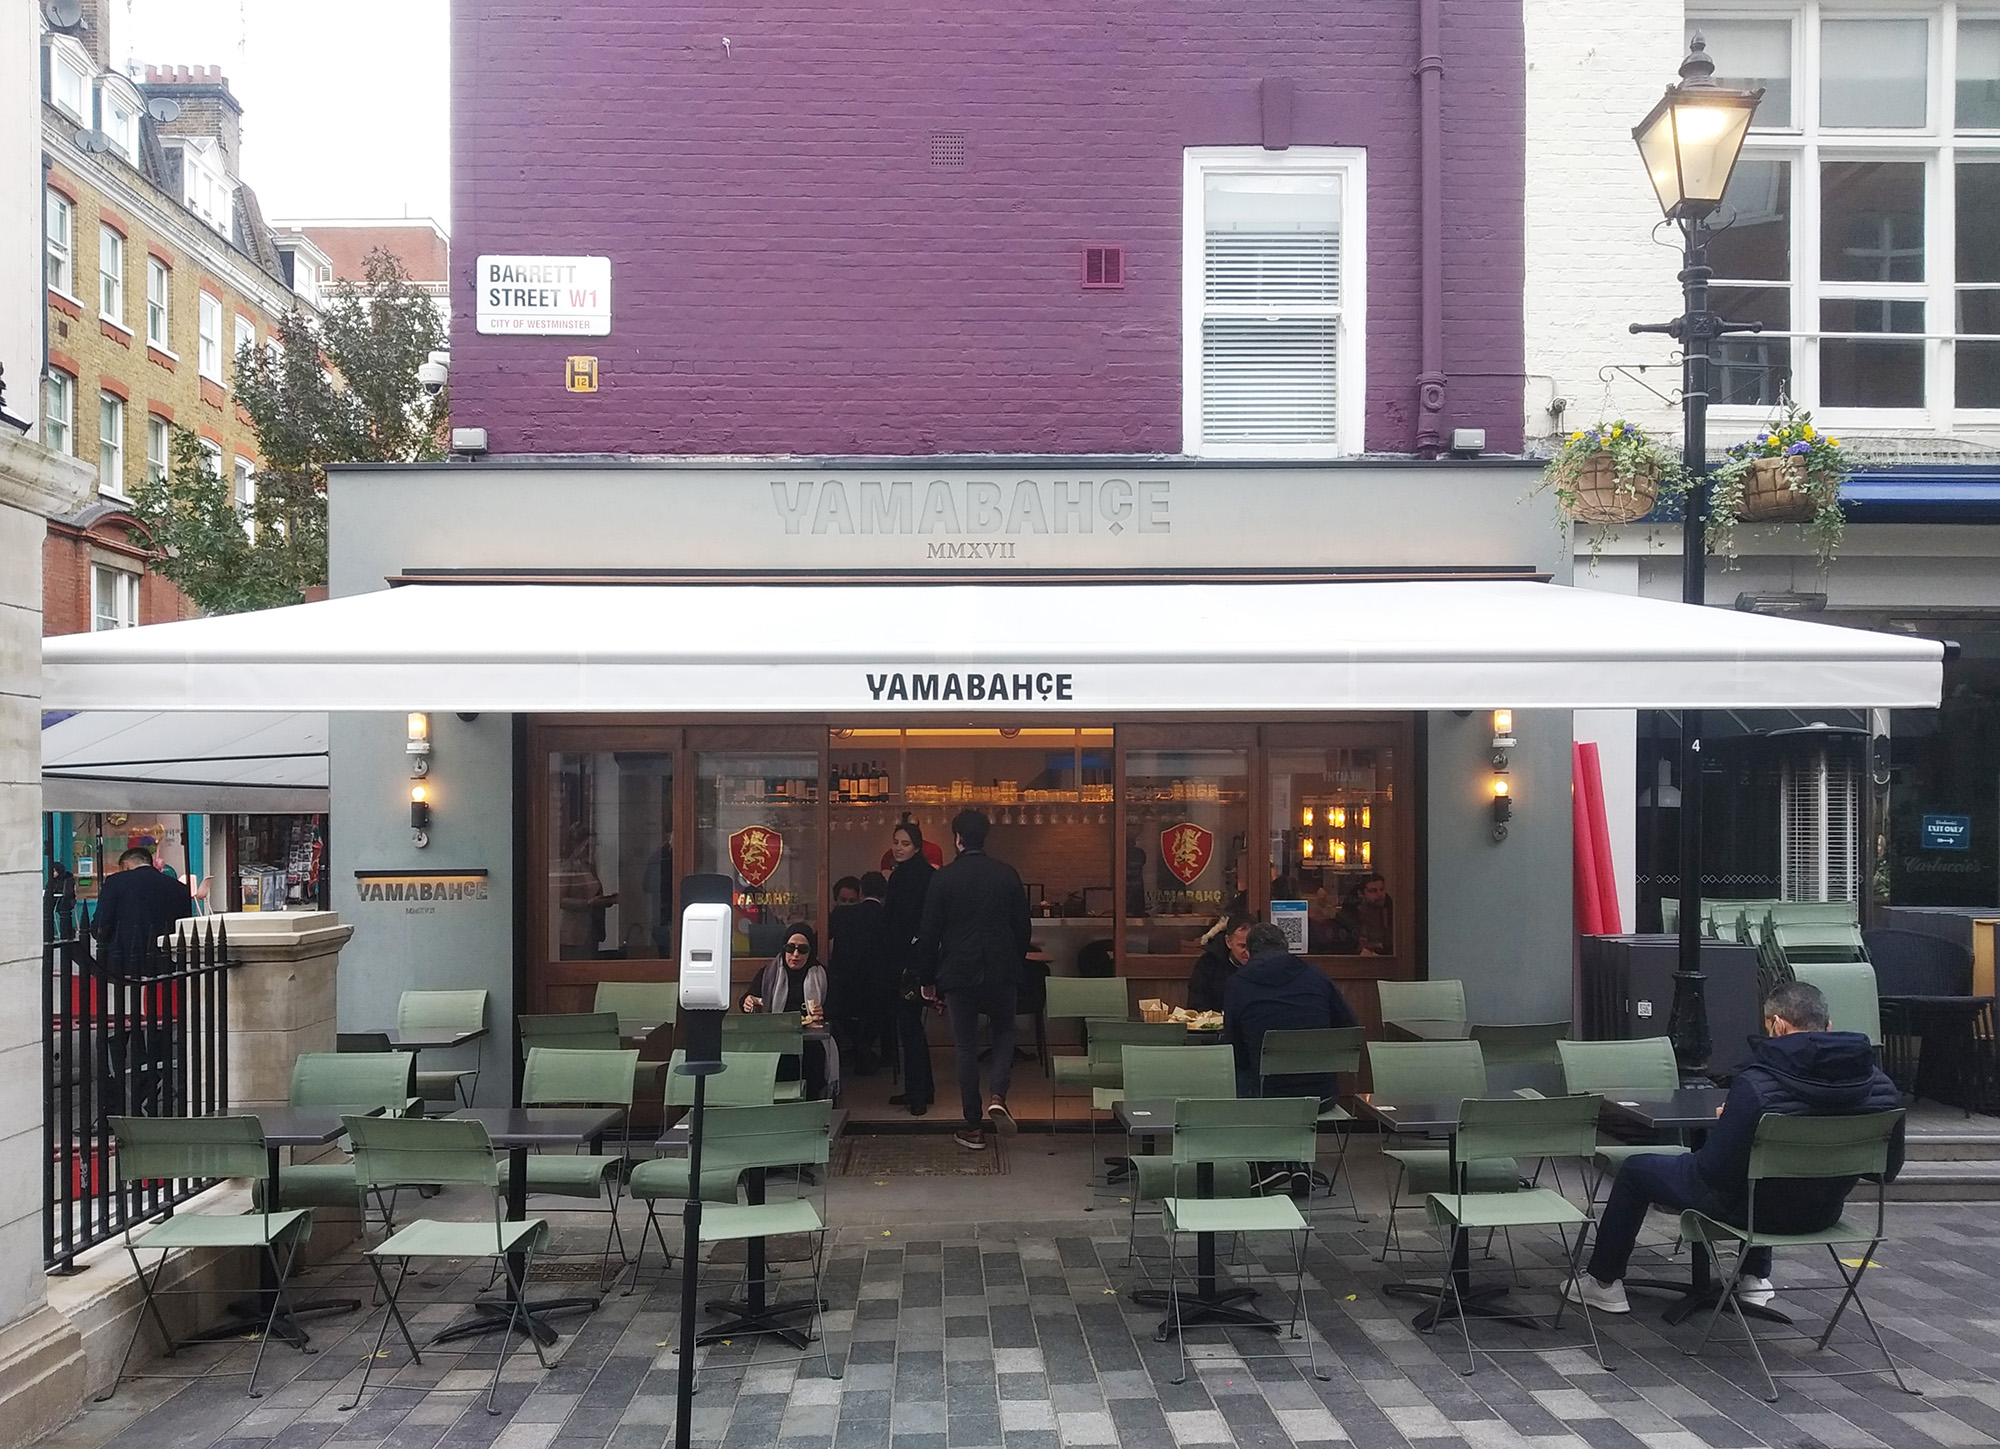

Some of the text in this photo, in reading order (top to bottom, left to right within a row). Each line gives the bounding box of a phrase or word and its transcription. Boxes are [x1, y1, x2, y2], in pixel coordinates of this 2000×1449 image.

[489, 264, 577, 283] BARRETT
[489, 288, 597, 308] STREET W1
[491, 319, 590, 329] CITY OF WESTMINSTER
[570, 360, 593, 388] H
[576, 378, 588, 386] 12
[770, 479, 1170, 536] YAMABAHÇE
[927, 542, 1016, 559] MMXVII
[866, 672, 1073, 701] YAMABAHÇE
[1691, 739, 1701, 752] 4
